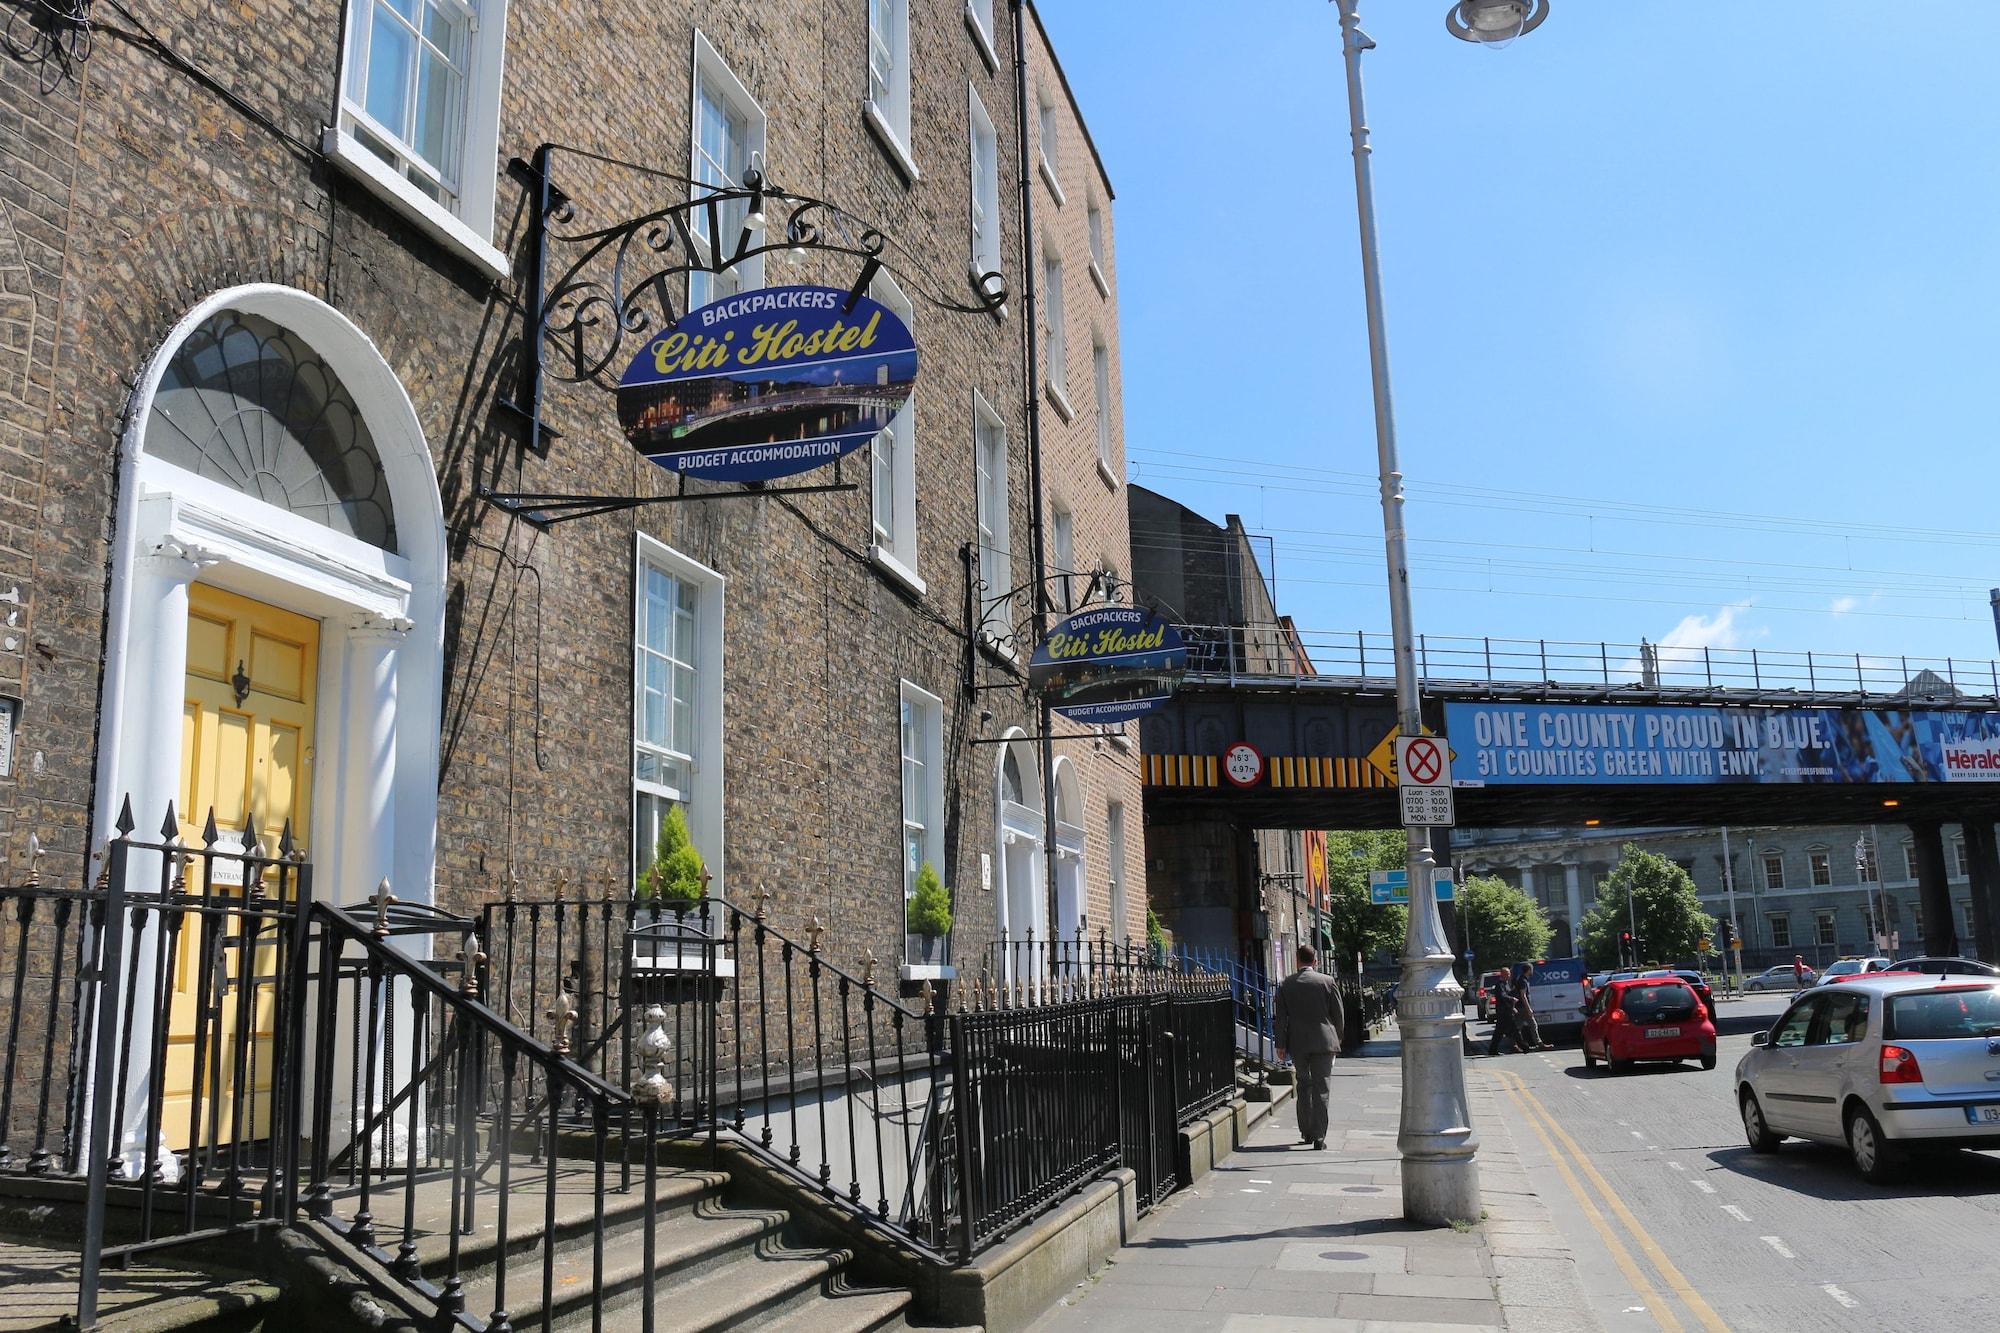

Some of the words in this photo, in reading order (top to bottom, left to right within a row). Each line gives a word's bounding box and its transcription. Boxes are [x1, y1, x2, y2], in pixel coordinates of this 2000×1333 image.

[701, 291, 838, 327] BACKPACKERS
[651, 331, 735, 374] Citi
[737, 310, 881, 365] Hostel
[678, 452, 728, 470] BUDGET
[730, 441, 841, 465] ACCOMMODATION
[1070, 611, 1142, 631] BACKPACKERS
[1047, 633, 1089, 659] Citi
[1092, 623, 1165, 655] Hostel
[1068, 707, 1094, 717] BUDGET
[1095, 701, 1152, 715] ACCOMMODATION
[1474, 711, 1529, 747] ONE
[1538, 712, 1636, 748] COUNTY
[1645, 714, 1724, 749] PROUD
[1732, 715, 1759, 749] IN
[1766, 716, 1831, 750] BLUE.
[1477, 750, 1499, 776] 31
[1505, 750, 1598, 776] COUNTIES
[1603, 750, 1662, 776] GREEN
[1667, 751, 1713, 776] WITH
[1718, 751, 1765, 776] ENVY.
[1431, 797, 1448, 805] 10.00
[1431, 806, 1448, 814] 19.00
[1410, 814, 1427, 822] MON
[1433, 814, 1445, 822] SAT
[213, 871, 243, 882] ENTRANC
